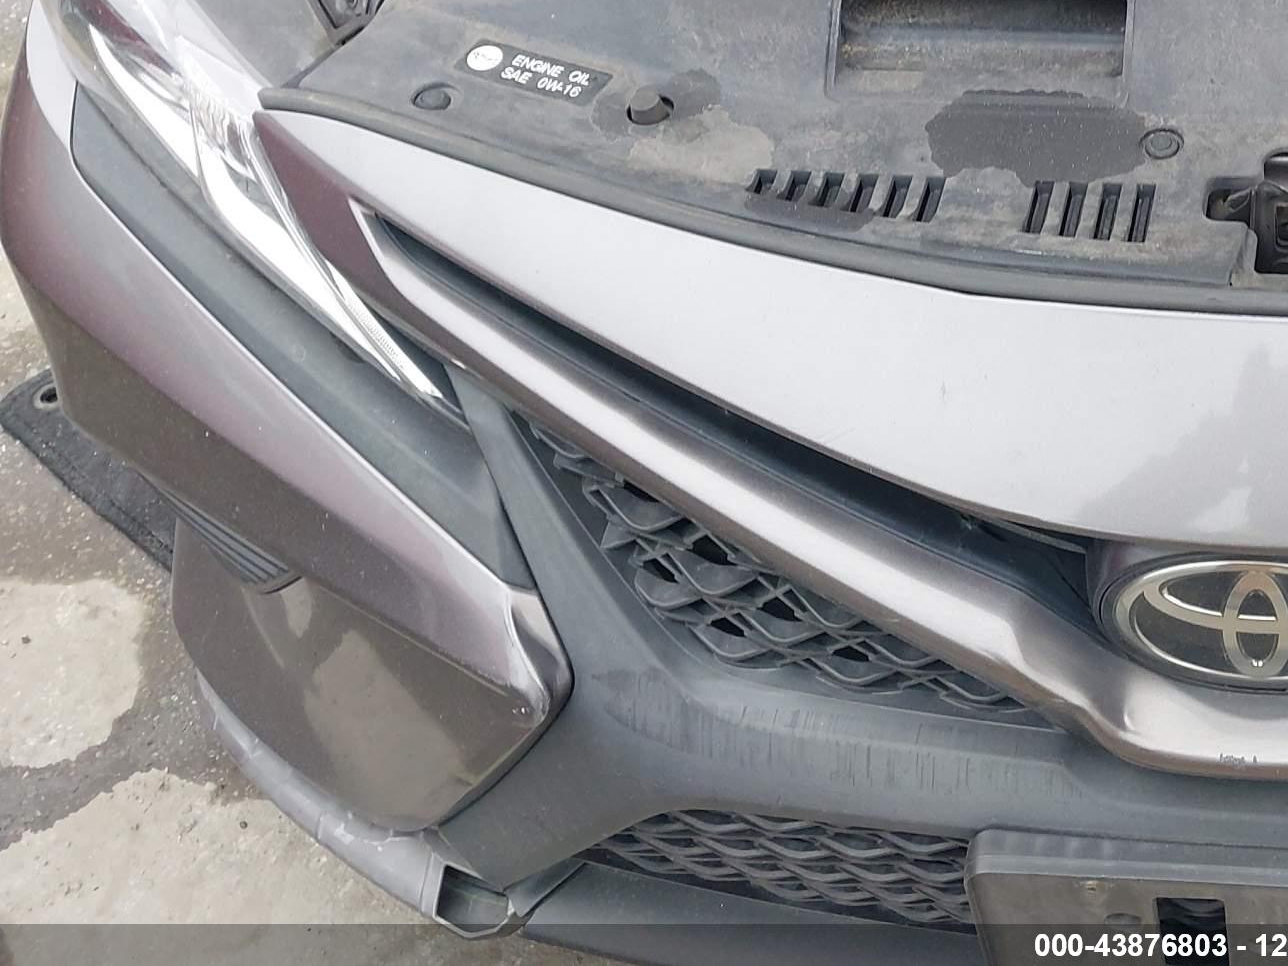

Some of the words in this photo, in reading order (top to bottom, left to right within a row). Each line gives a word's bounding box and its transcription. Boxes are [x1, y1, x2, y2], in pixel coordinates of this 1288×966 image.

[500, 66, 533, 85] SAE
[537, 76, 582, 98] 0W-16
[511, 54, 565, 78] ENGINE
[568, 70, 590, 86] OIL
